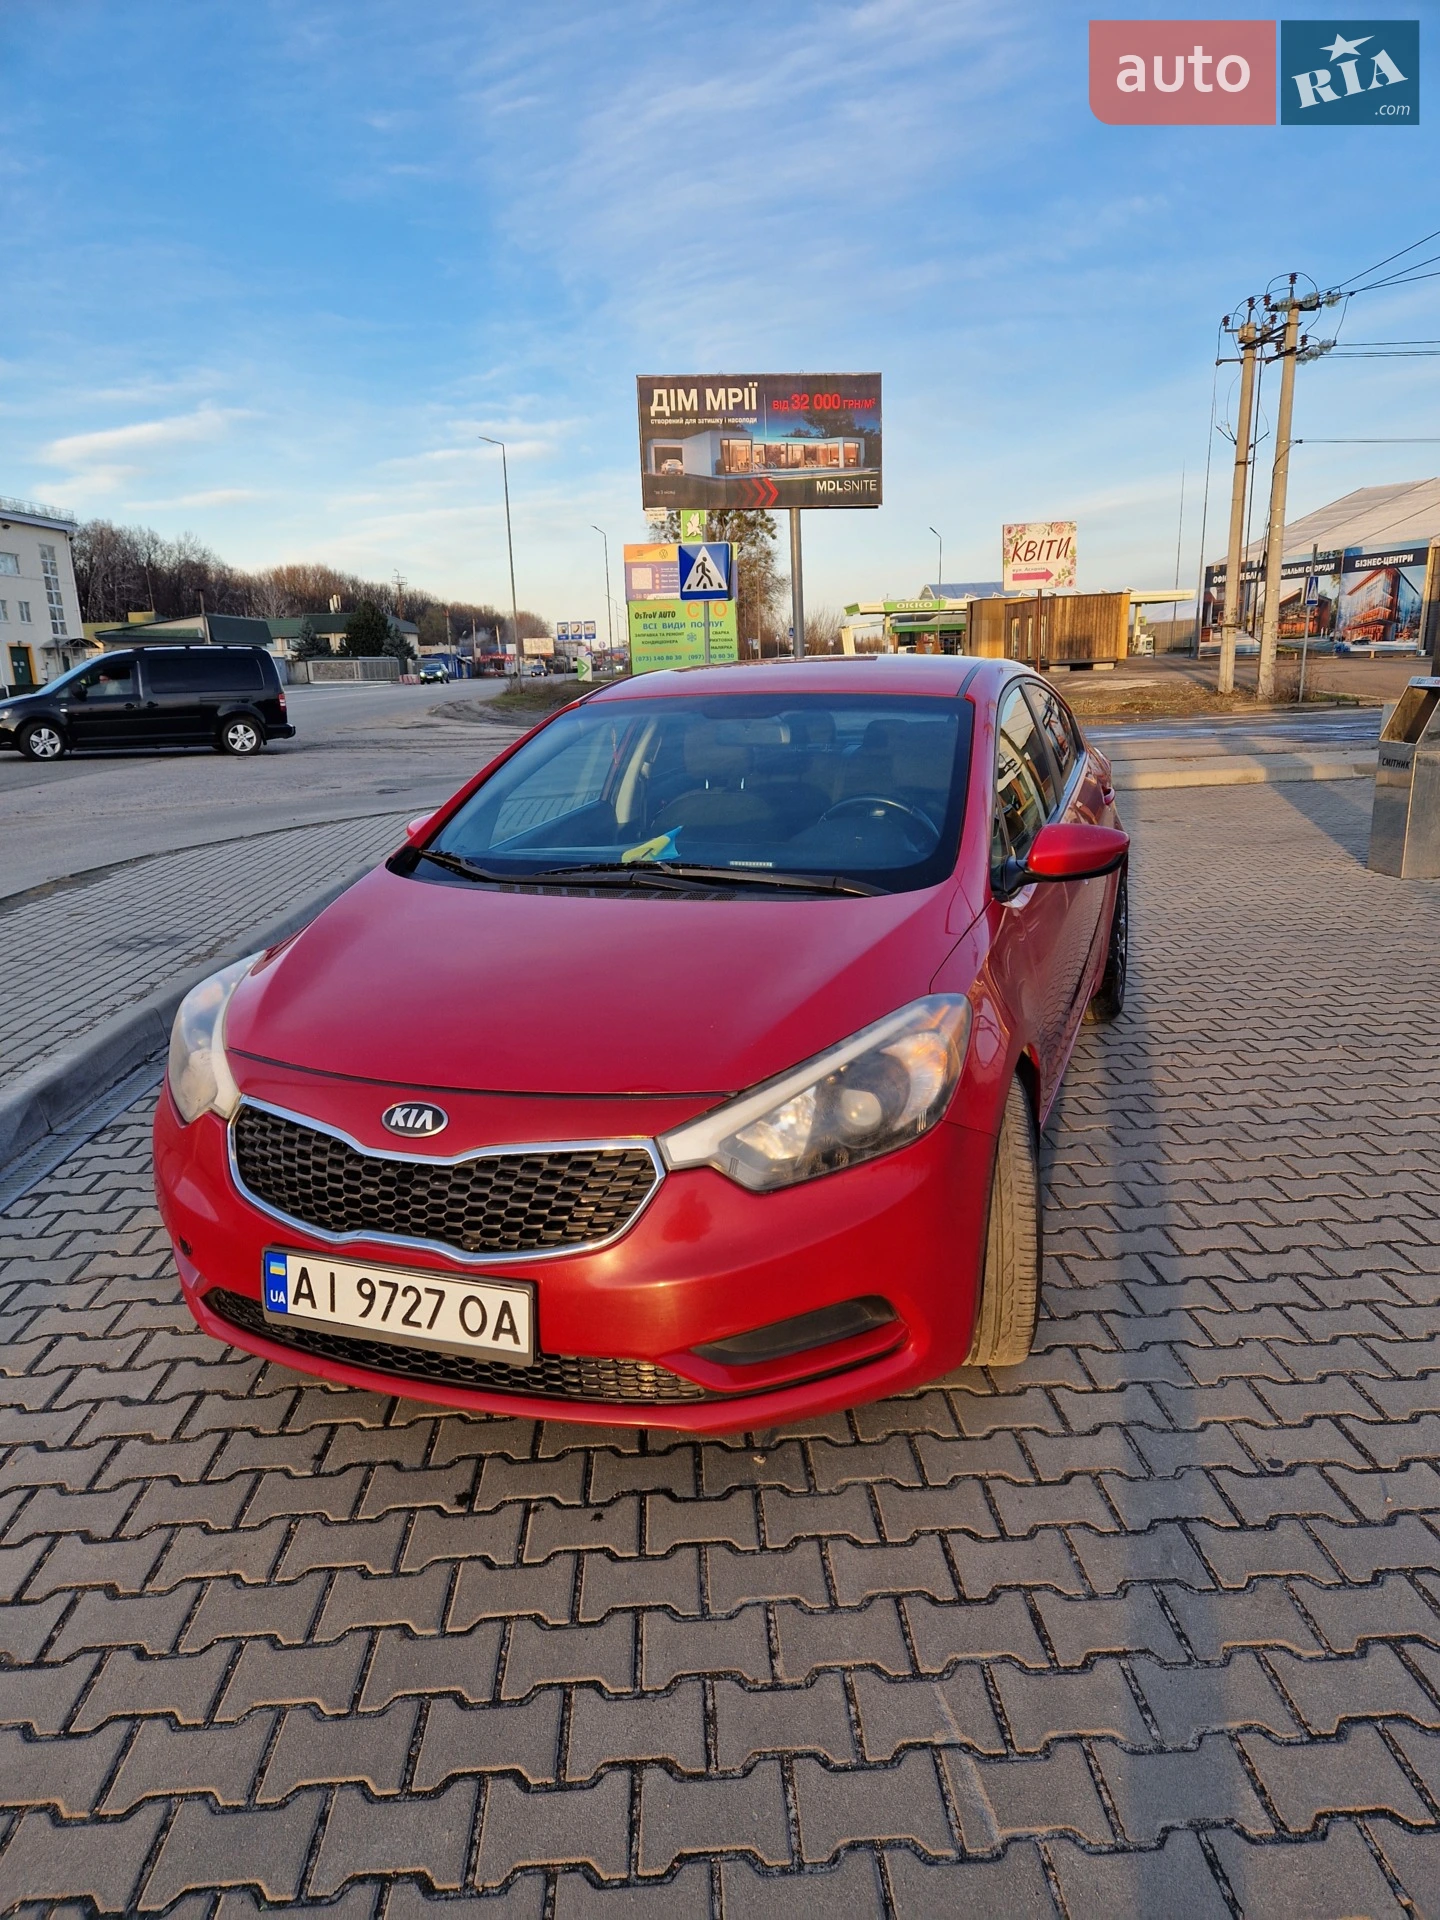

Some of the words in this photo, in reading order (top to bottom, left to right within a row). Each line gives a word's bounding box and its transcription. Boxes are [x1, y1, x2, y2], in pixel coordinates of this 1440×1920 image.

[650, 388, 698, 417] ДІМ
[705, 382, 758, 411] МРІЇ
[791, 393, 809, 410] 32
[813, 393, 840, 410] 000
[650, 417, 684, 426] створений
[684, 418, 696, 426] для
[698, 417, 723, 426] затишку
[728, 417, 758, 425] насолоди
[1011, 536, 1072, 563] КВІТИ
[1354, 553, 1414, 568] БІЗНЕС-ЦЕНТРИ
[658, 610, 676, 619] AUTO
[643, 622, 657, 630] ВСІ
[662, 621, 686, 630] ВИДИ
[1382, 757, 1410, 770] СМІТНИК
[390, 1107, 433, 1130] KIA
[270, 1289, 286, 1305] UA
[292, 1266, 336, 1313] AI
[356, 1277, 446, 1330] 9727
[458, 1294, 521, 1346] OA
